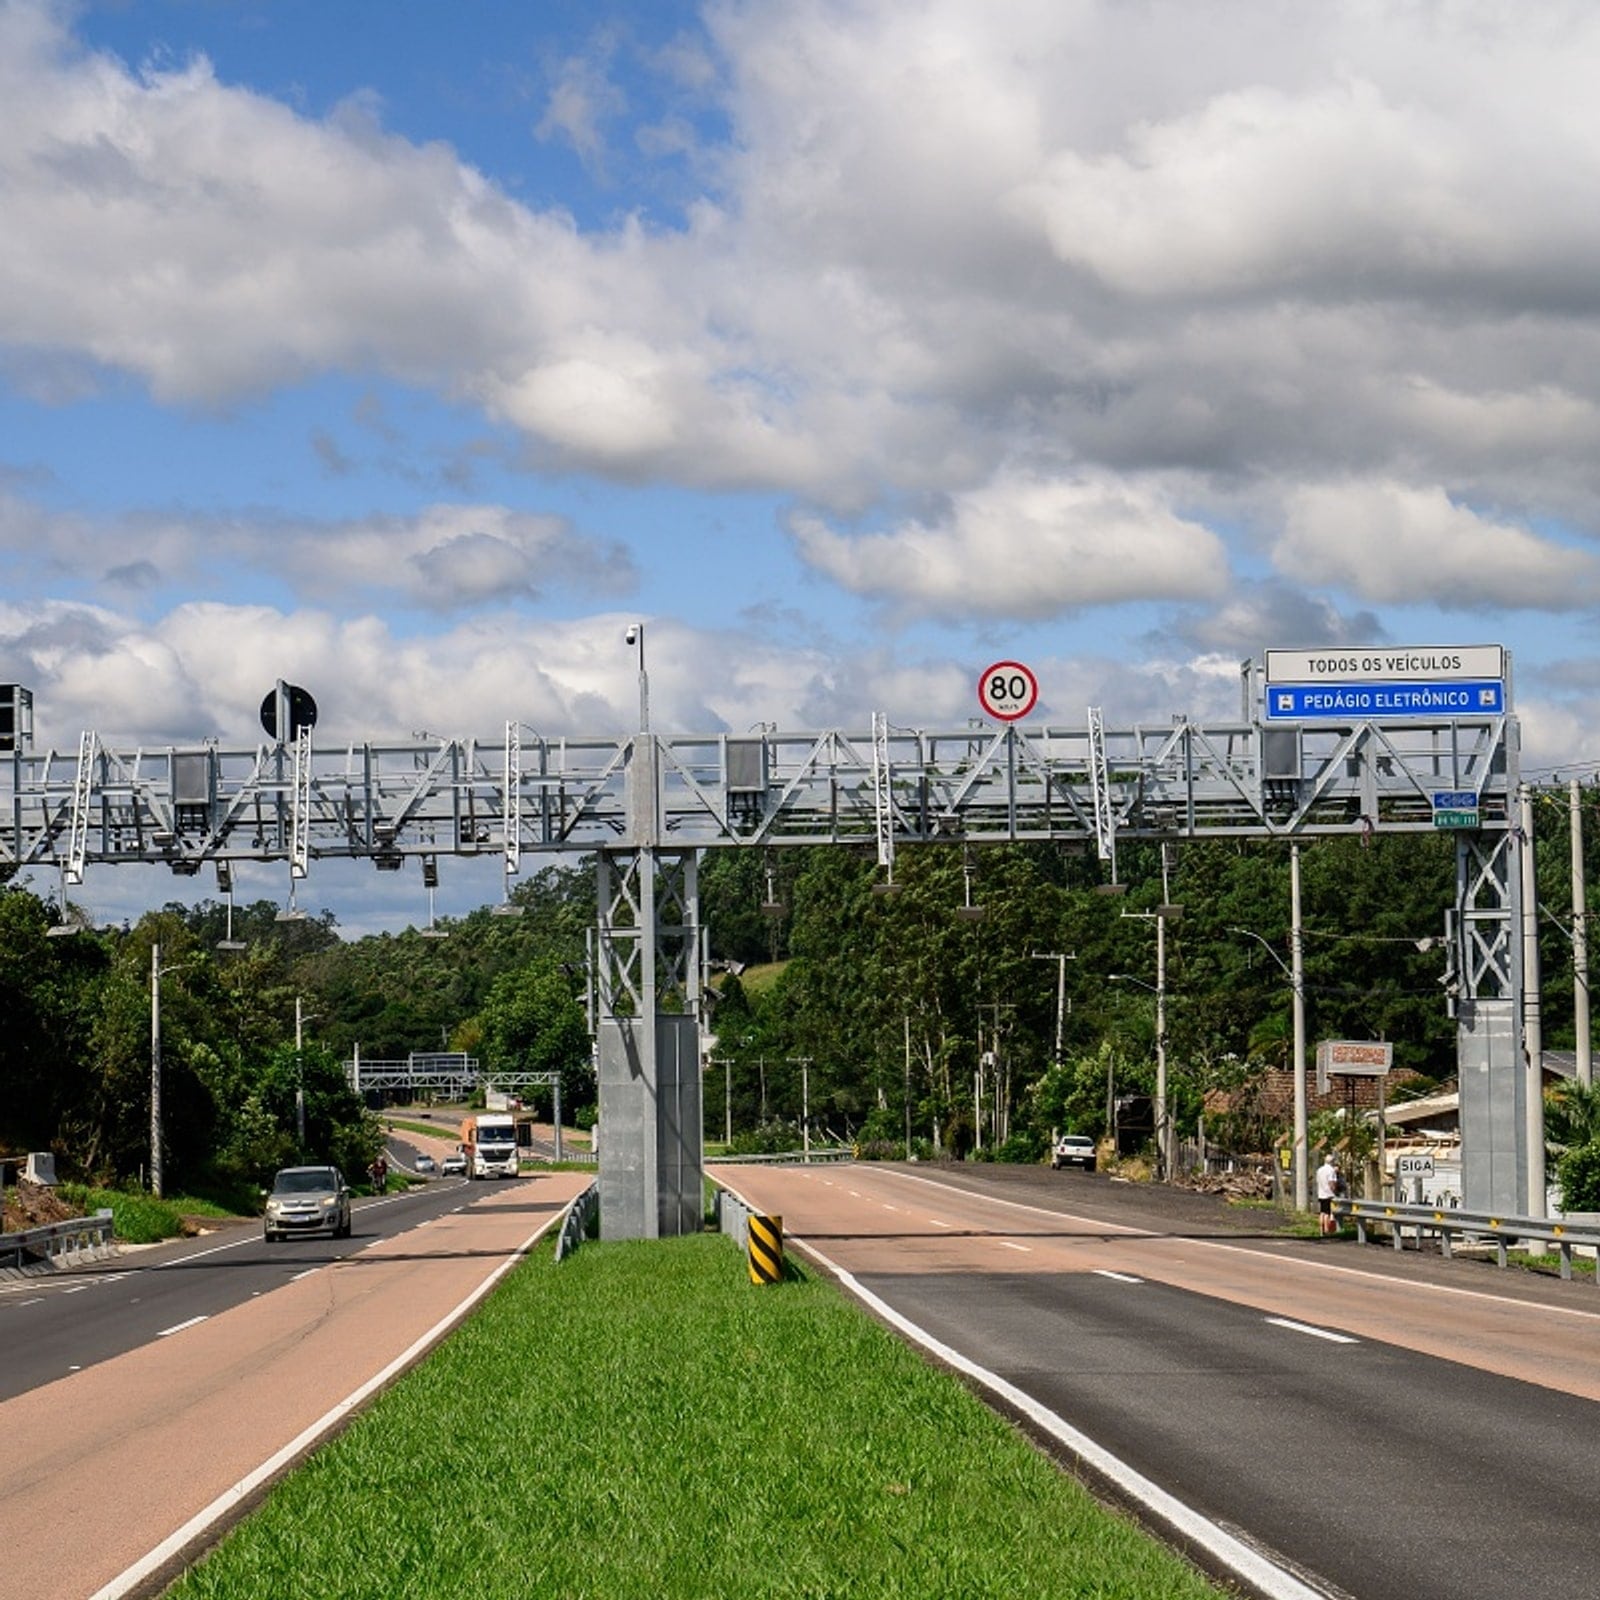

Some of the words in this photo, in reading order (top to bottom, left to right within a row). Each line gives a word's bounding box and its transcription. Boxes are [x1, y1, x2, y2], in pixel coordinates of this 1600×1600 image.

[1308, 659, 1358, 673] TODOS
[1362, 658, 1382, 672] OS
[1386, 653, 1462, 671] VEÍCULOS
[990, 676, 1026, 699] 80
[1304, 690, 1370, 709] PEDÁGIO
[1375, 688, 1470, 708] ELETRÔNICO
[1400, 1160, 1432, 1172] SIGA
